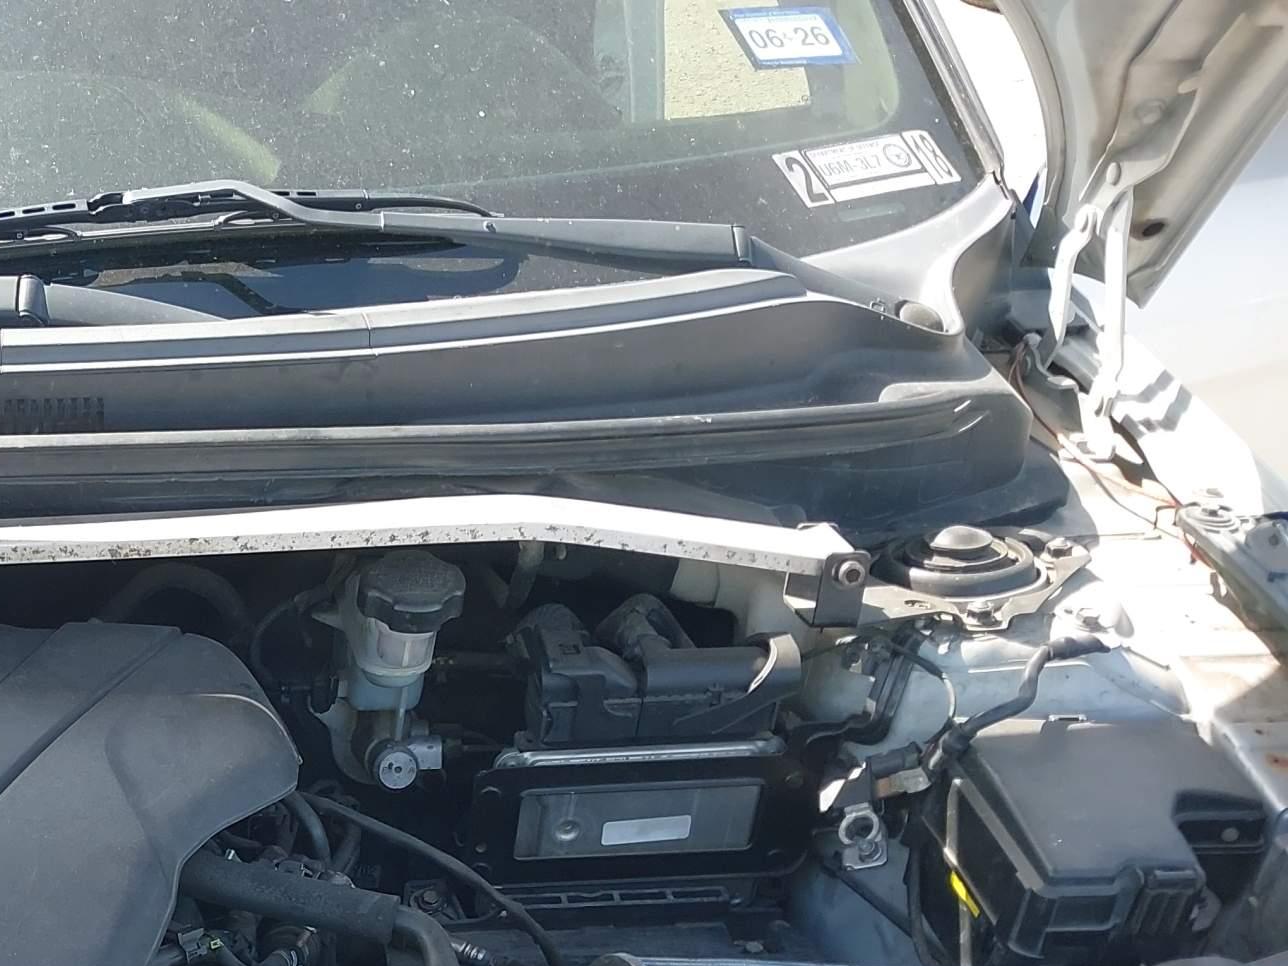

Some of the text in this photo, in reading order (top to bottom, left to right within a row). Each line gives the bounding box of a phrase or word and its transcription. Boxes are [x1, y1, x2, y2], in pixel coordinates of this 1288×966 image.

[748, 26, 831, 49] 06 26
[784, 156, 829, 204] 2
[910, 134, 953, 180] 18
